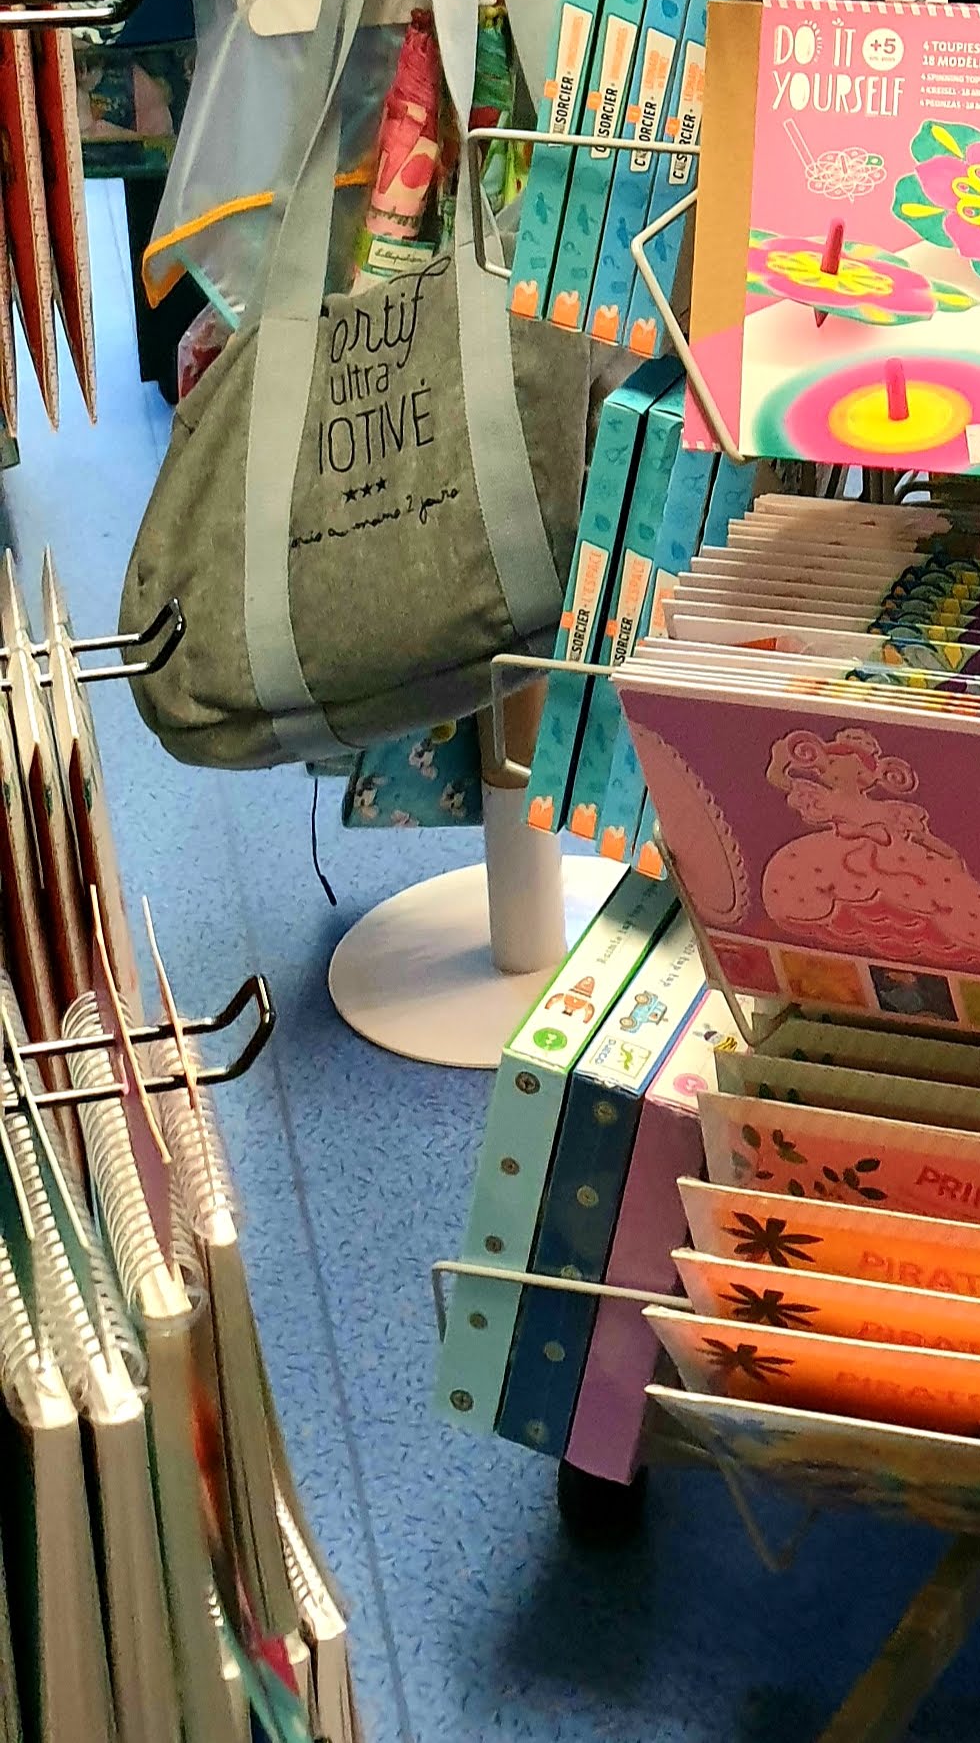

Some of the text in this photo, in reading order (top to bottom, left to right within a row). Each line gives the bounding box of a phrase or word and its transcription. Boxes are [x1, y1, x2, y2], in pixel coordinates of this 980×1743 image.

[774, 18, 896, 68] DO IT +5
[922, 55, 936, 66] 18
[923, 41, 980, 54] 4 TOUPIES
[555, 75, 574, 124] SORCIER
[598, 88, 618, 138] SORCIER
[772, 70, 905, 117] YOURSELF
[639, 101, 657, 142] ORCIER
[676, 113, 696, 163] SRCIER
[330, 256, 451, 369] ortif
[330, 362, 390, 406] ultra
[571, 609, 591, 655] SORCIER
[614, 617, 633, 664] SORCIER
